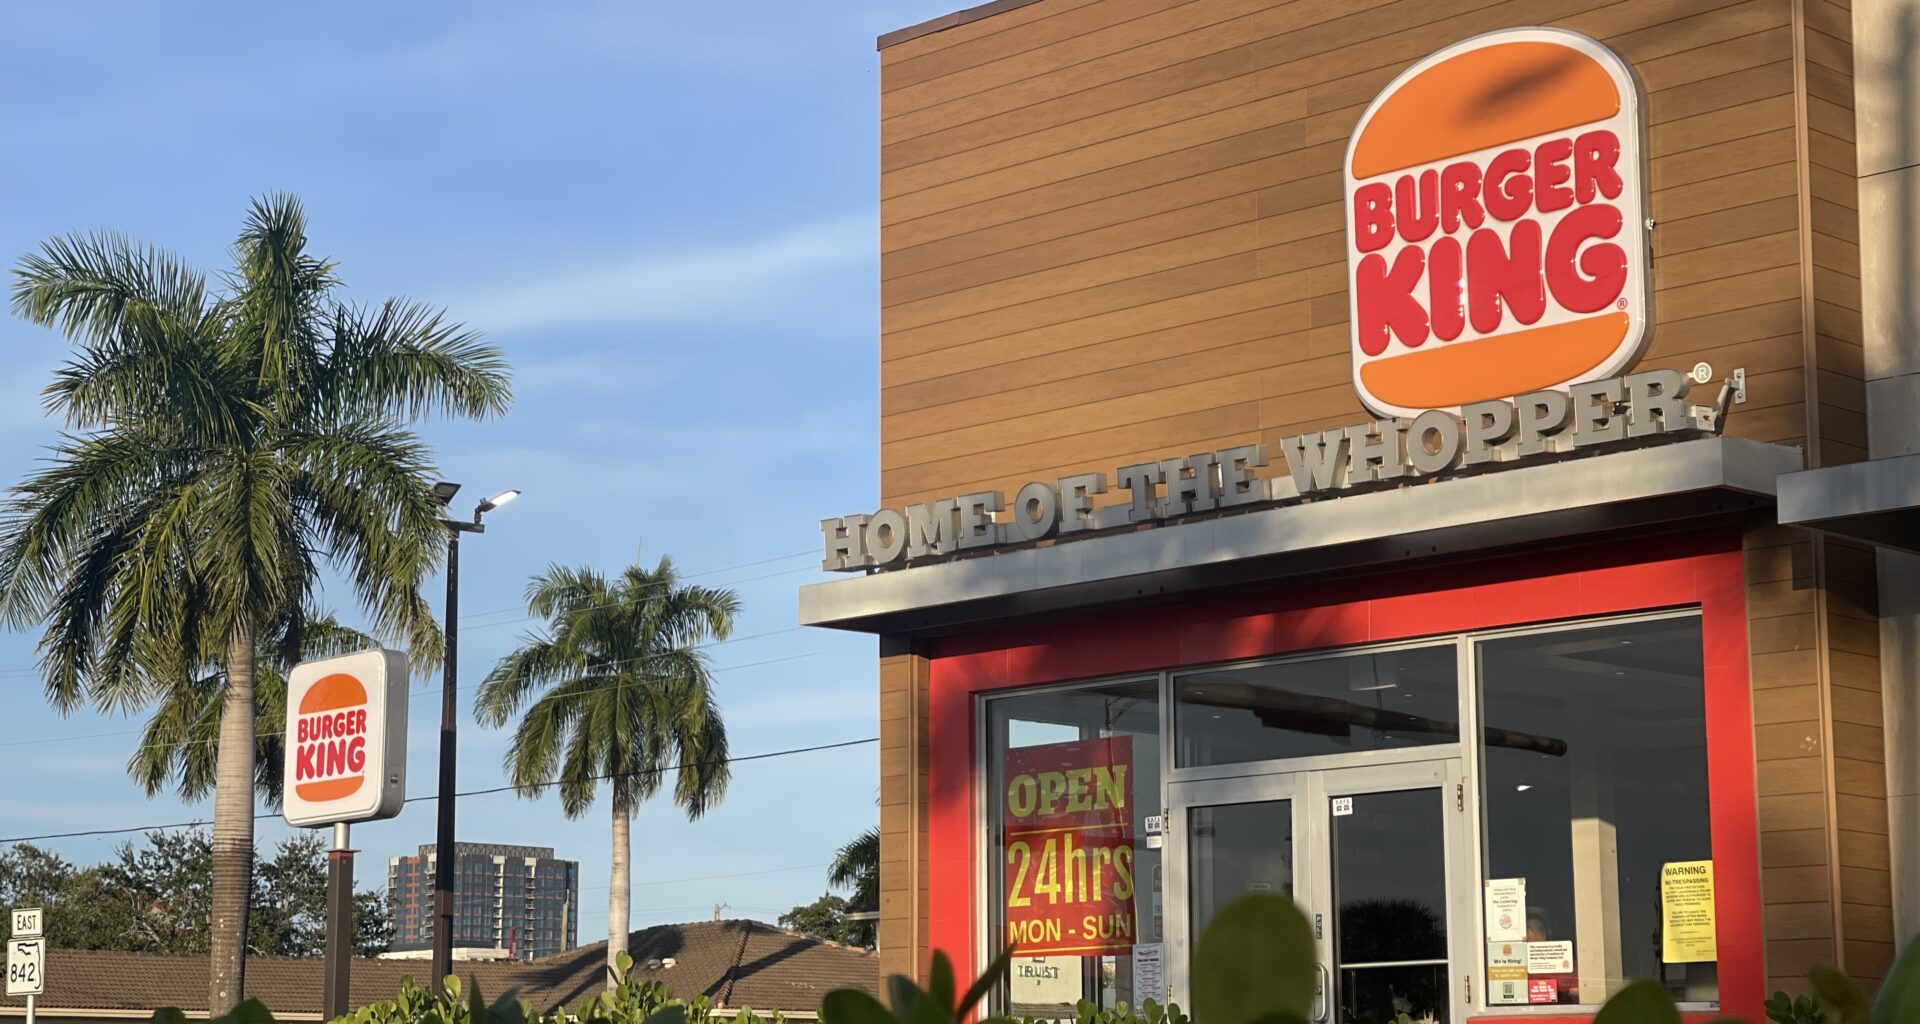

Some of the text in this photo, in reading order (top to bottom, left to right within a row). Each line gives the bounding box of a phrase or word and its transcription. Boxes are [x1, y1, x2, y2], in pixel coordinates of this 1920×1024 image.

[1354, 129, 1623, 254] BURGER
[1356, 203, 1628, 357] KING
[820, 490, 1005, 572] HOME
[1014, 472, 1106, 540] OF
[1117, 443, 1269, 522] THE
[1280, 369, 1690, 494] WHOPPER
[297, 709, 367, 743] BURGER
[296, 736, 366, 781] KING
[1008, 764, 1128, 818] OPEN
[1008, 833, 1133, 907] 24hrs
[1665, 866, 1706, 876] WARNING
[1672, 877, 1709, 885] TRESPASSING
[17, 914, 37, 931] EAST
[1009, 918, 1062, 944] MON
[1082, 913, 1131, 940] SUN
[10, 962, 36, 983] 842
